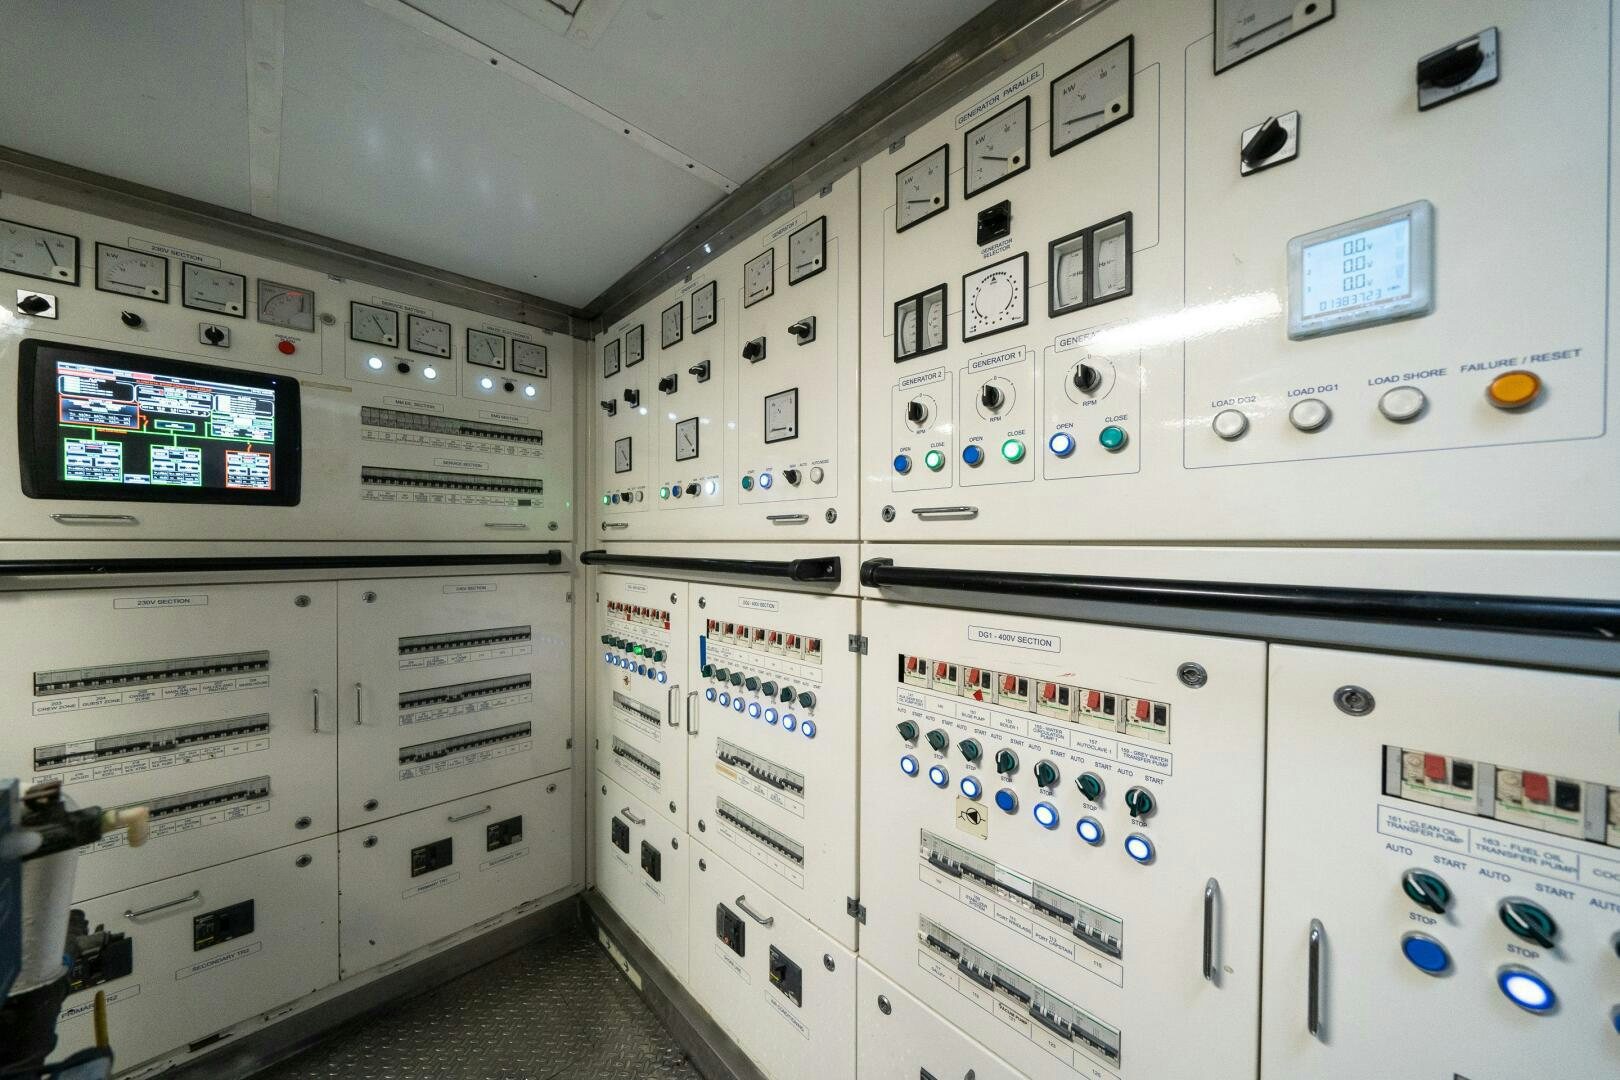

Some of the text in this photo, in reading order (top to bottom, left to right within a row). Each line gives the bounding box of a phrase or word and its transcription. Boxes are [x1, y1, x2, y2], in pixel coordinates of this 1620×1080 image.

[958, 71, 1040, 124] GENERATOR PARALLEL
[171, 250, 203, 262] SECTION
[972, 351, 1016, 369] GENERATOR
[1460, 357, 1518, 373] FAILURE
[1530, 348, 1583, 363] RESET
[902, 373, 937, 387] GENERATOR
[1368, 368, 1447, 386] LOAD SHORE
[1287, 384, 1339, 398] LOAD DG1
[1212, 398, 1235, 408] LOAD
[1105, 415, 1128, 423] CLOSE
[978, 630, 992, 639] DG1
[998, 633, 1015, 642] 400V
[1017, 636, 1052, 647] SECTION
[974, 728, 988, 736] START
[990, 733, 1003, 741] AUTO
[1010, 738, 1025, 746] START
[1028, 744, 1042, 752] AUTO
[1050, 749, 1066, 758] START
[1070, 755, 1085, 763] AUTO
[1123, 752, 1169, 769] TRANSFER PUMP
[1133, 750, 1149, 758] GREY
[1094, 761, 1113, 771] START
[1117, 768, 1134, 777] AUTO
[1144, 775, 1164, 785] START
[1082, 802, 1098, 811] STOP
[1131, 818, 1148, 828] STOP
[1409, 820, 1441, 832] CLEAN
[1442, 827, 1457, 837] OIL
[1386, 820, 1465, 844] TRANSFER PUMP
[1385, 842, 1413, 856] AUTO
[1510, 843, 1539, 857] FUEL
[1543, 851, 1563, 863] OIL
[1433, 855, 1467, 870] START
[1476, 843, 1578, 874] TRANSFER PUMP
[1479, 868, 1511, 882] AUTO
[1536, 883, 1575, 900] START
[1409, 912, 1437, 926] STOP
[1507, 943, 1540, 959] STOP
[191, 953, 235, 973] SECONDARY
[61, 1003, 95, 1020] PRIMAR
